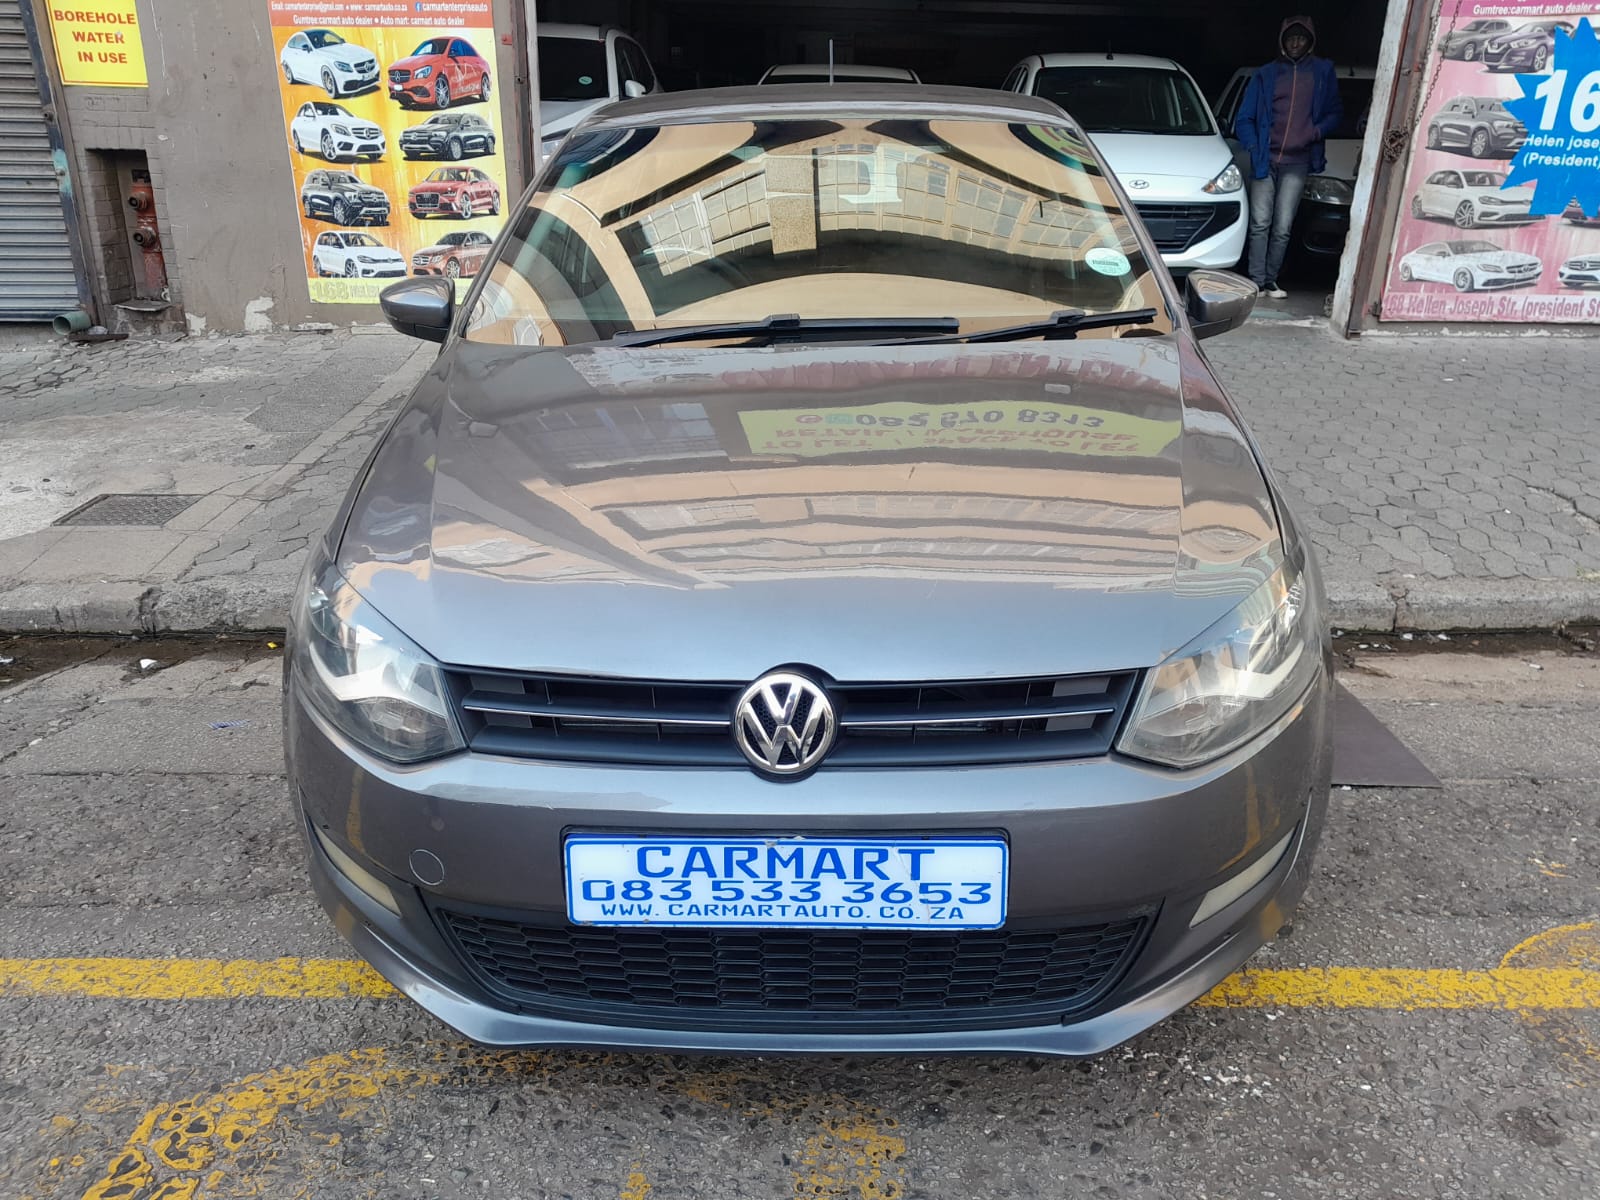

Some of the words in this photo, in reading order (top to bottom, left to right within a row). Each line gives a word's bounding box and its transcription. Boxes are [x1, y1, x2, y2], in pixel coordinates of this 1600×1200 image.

[54, 9, 137, 25] BOREHOLE
[1544, 4, 1564, 14] auto
[1566, 3, 1592, 13] dealer
[72, 31, 125, 44] WATER
[78, 51, 94, 63] IN
[98, 52, 127, 64] USE
[1523, 134, 1565, 147] Helen
[1566, 135, 1600, 152] jose
[1448, 294, 1492, 317] Joseph
[1497, 295, 1518, 316] Str.
[1521, 296, 1585, 320] (president
[637, 846, 935, 881] CARMART
[582, 880, 691, 902] 083
[712, 880, 821, 903] 533
[842, 881, 991, 905] 3653
